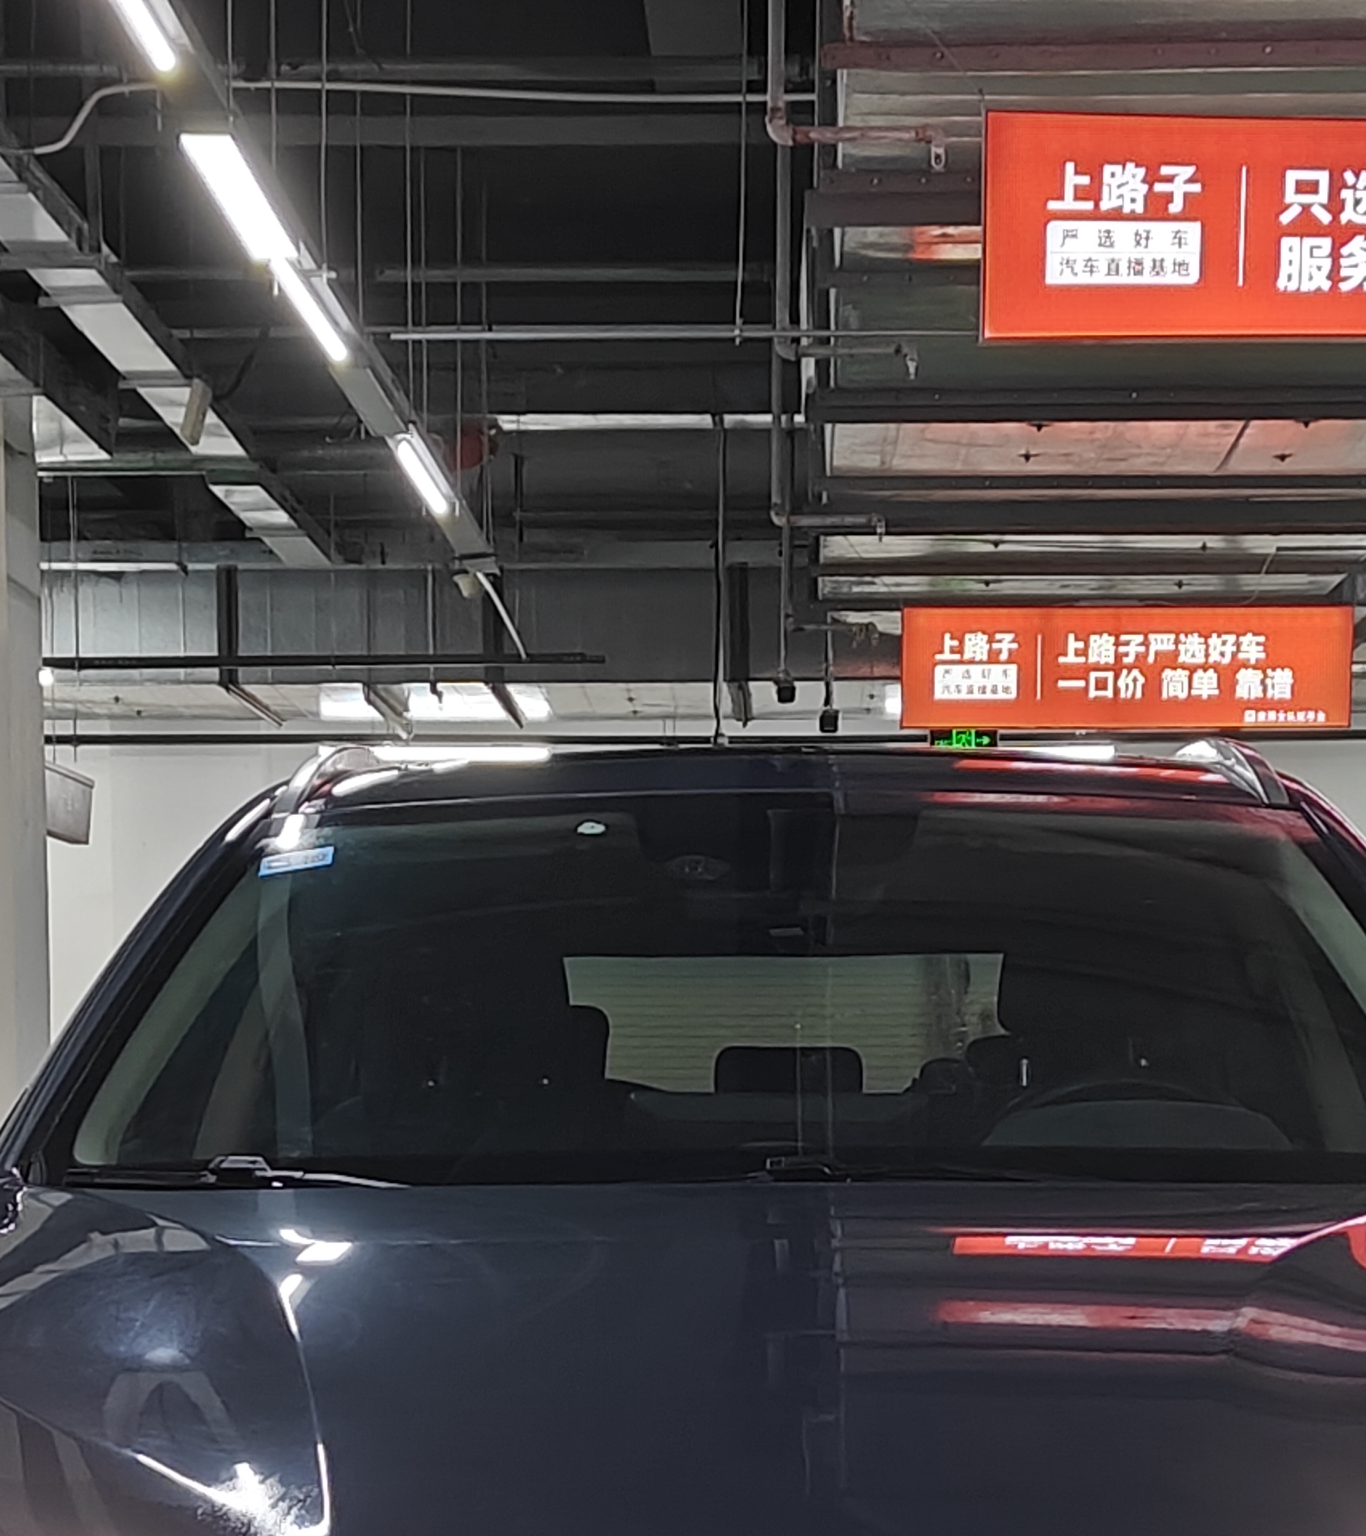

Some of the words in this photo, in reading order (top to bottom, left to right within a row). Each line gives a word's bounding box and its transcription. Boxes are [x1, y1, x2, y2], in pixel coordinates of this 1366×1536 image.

[1046, 161, 1202, 214] 上路子
[1059, 228, 1189, 249] 严选好车
[1059, 256, 1191, 277] 汽车直播基地
[934, 632, 1019, 662] 上路子
[1057, 632, 1266, 664] 上路子严选好车
[1056, 668, 1145, 699] 一口价
[1161, 668, 1220, 699] 简单
[1235, 668, 1294, 699] 靠谱
